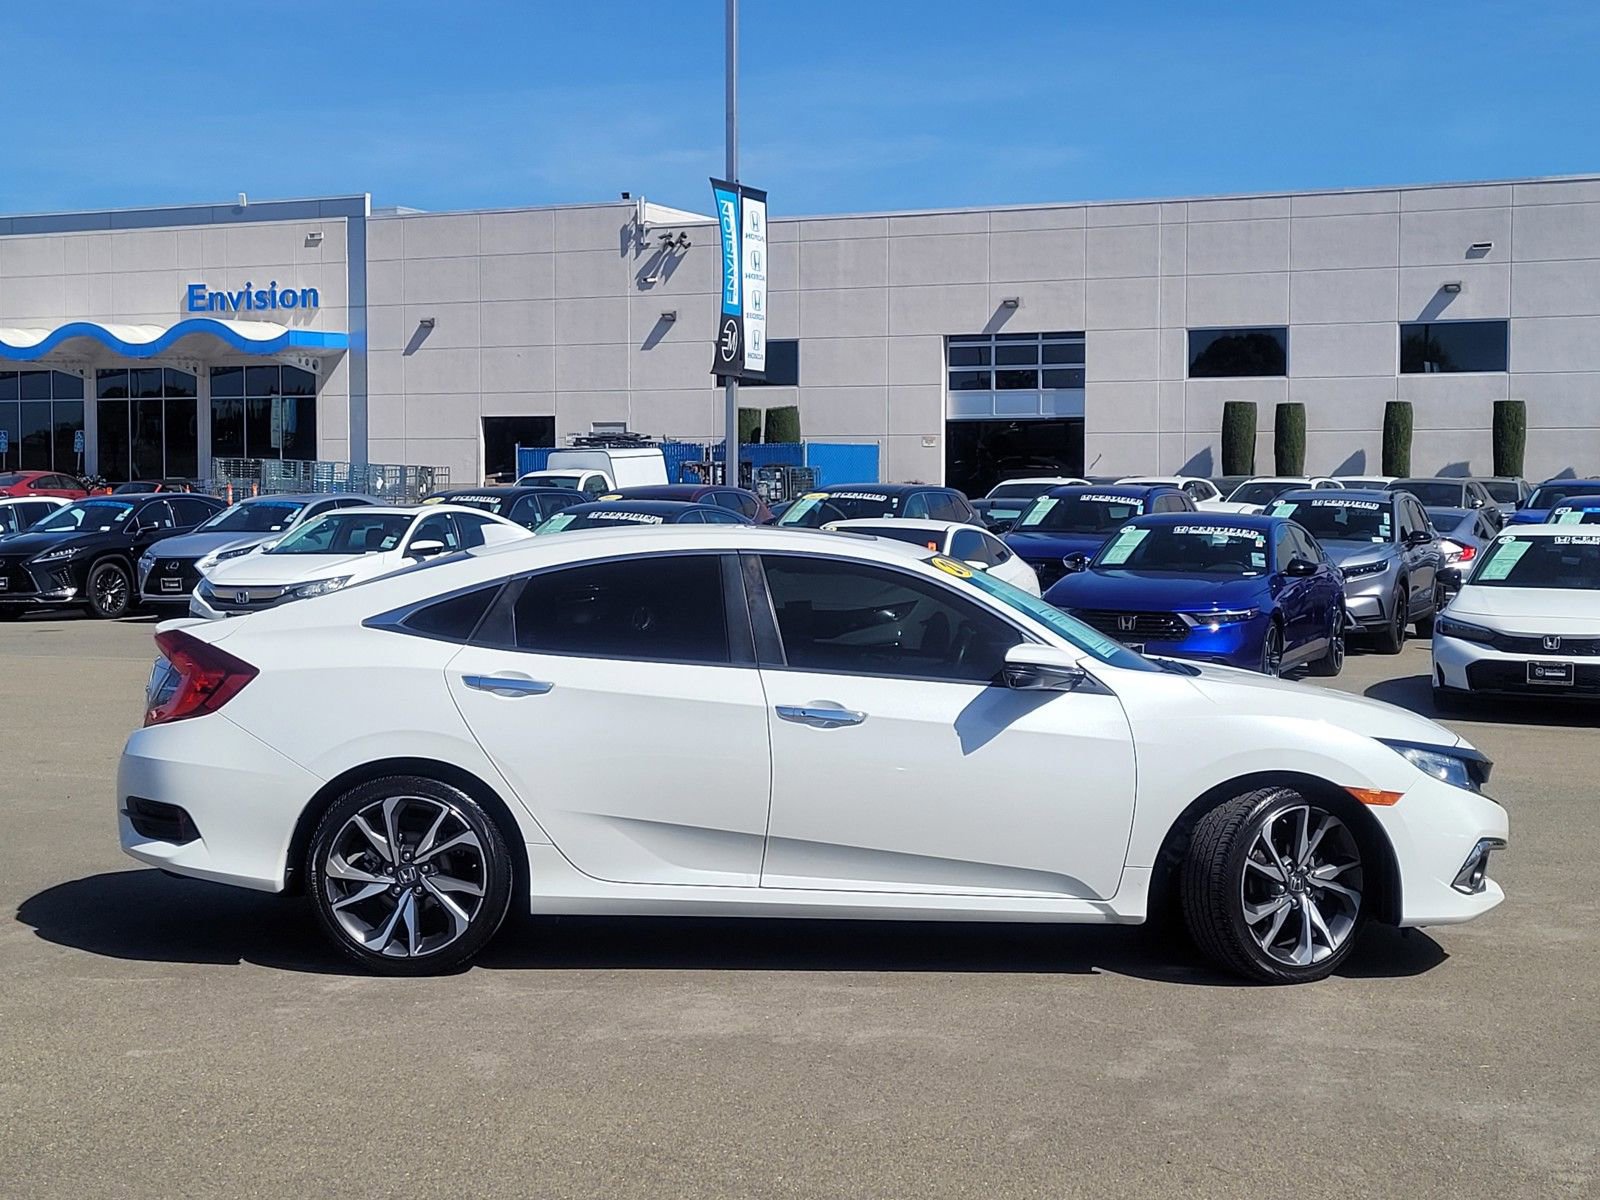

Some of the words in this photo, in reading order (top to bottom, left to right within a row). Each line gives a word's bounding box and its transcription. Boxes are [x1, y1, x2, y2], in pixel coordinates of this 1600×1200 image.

[720, 200, 737, 305] ENVISION
[188, 281, 319, 312] Envision
[1188, 526, 1259, 540] CERTIFIED
